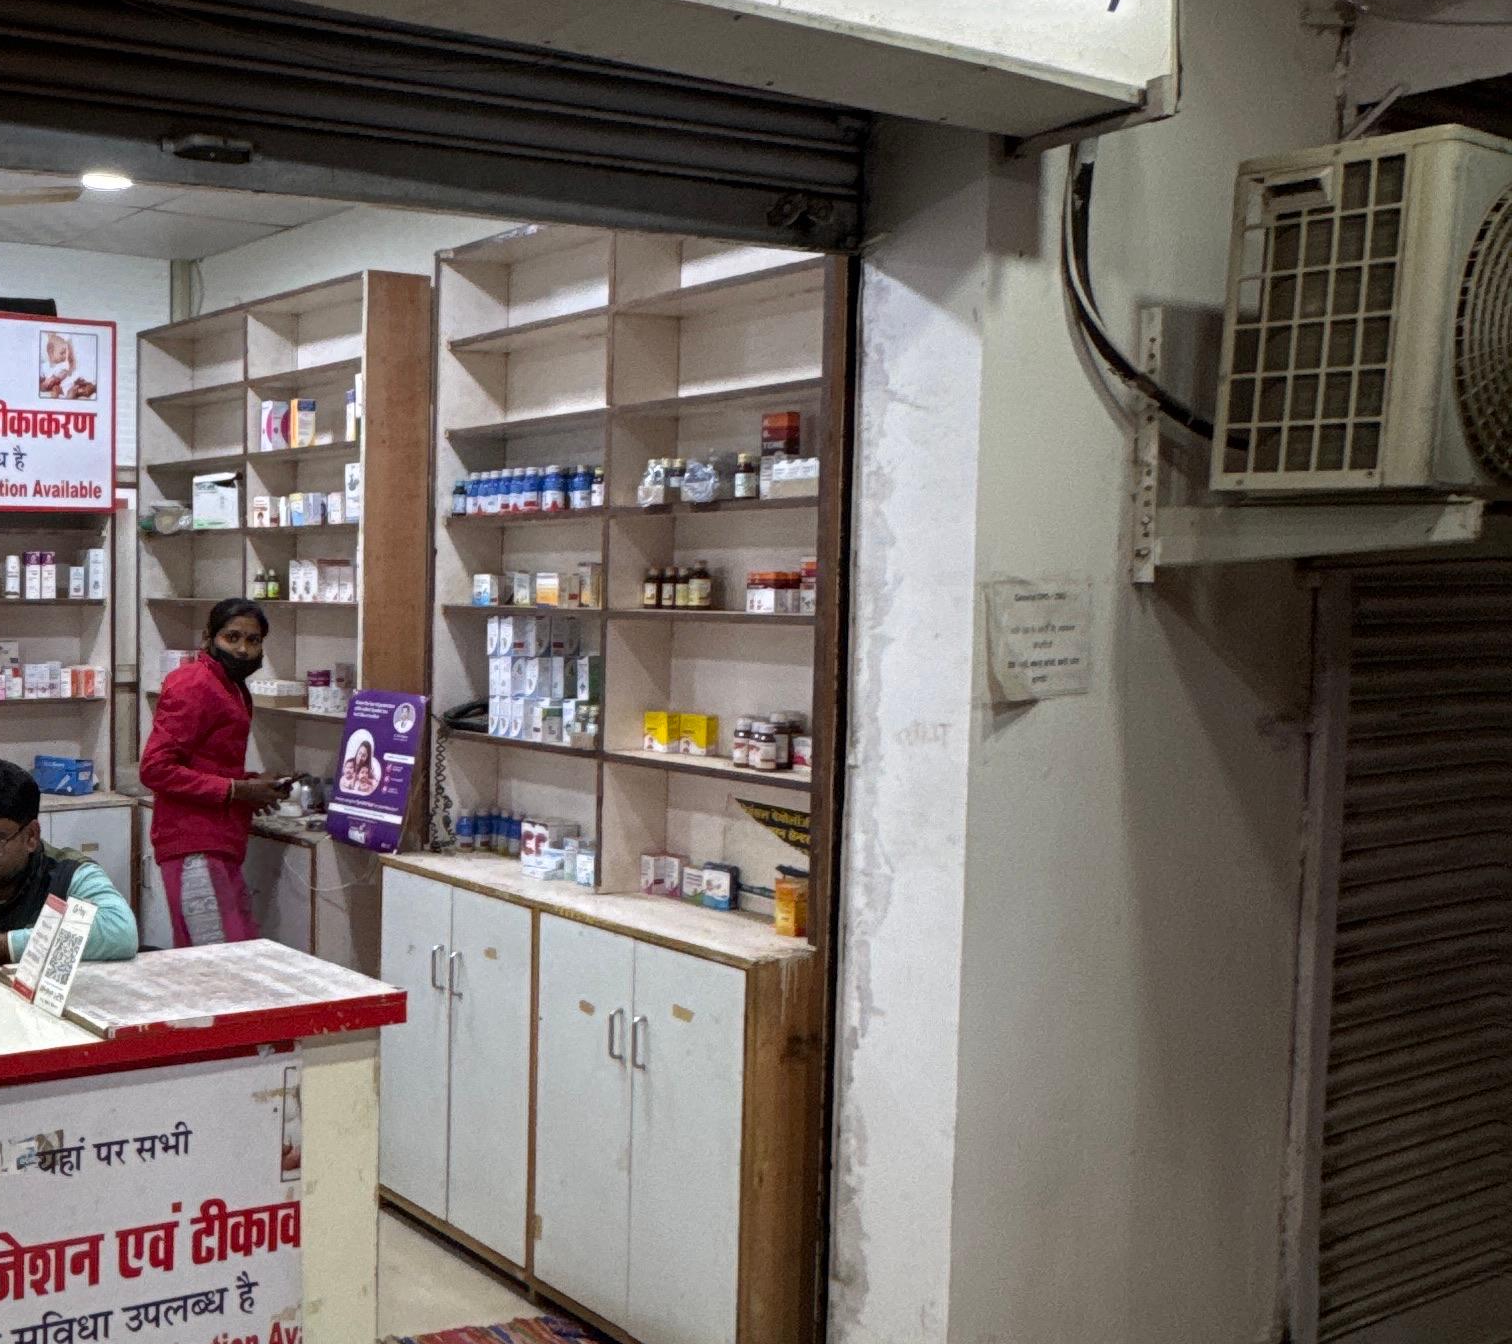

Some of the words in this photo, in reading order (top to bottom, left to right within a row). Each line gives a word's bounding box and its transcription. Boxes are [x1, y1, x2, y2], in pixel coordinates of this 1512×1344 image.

[13, 445, 27, 472] है
[31, 479, 103, 500] Available
[37, 1137, 85, 1176] यहां
[93, 1139, 130, 1167] पर
[133, 1121, 193, 1162] सभी
[115, 1201, 184, 1280] एवं
[121, 1286, 229, 1333] उपलब्ध
[235, 1270, 259, 1314] है
